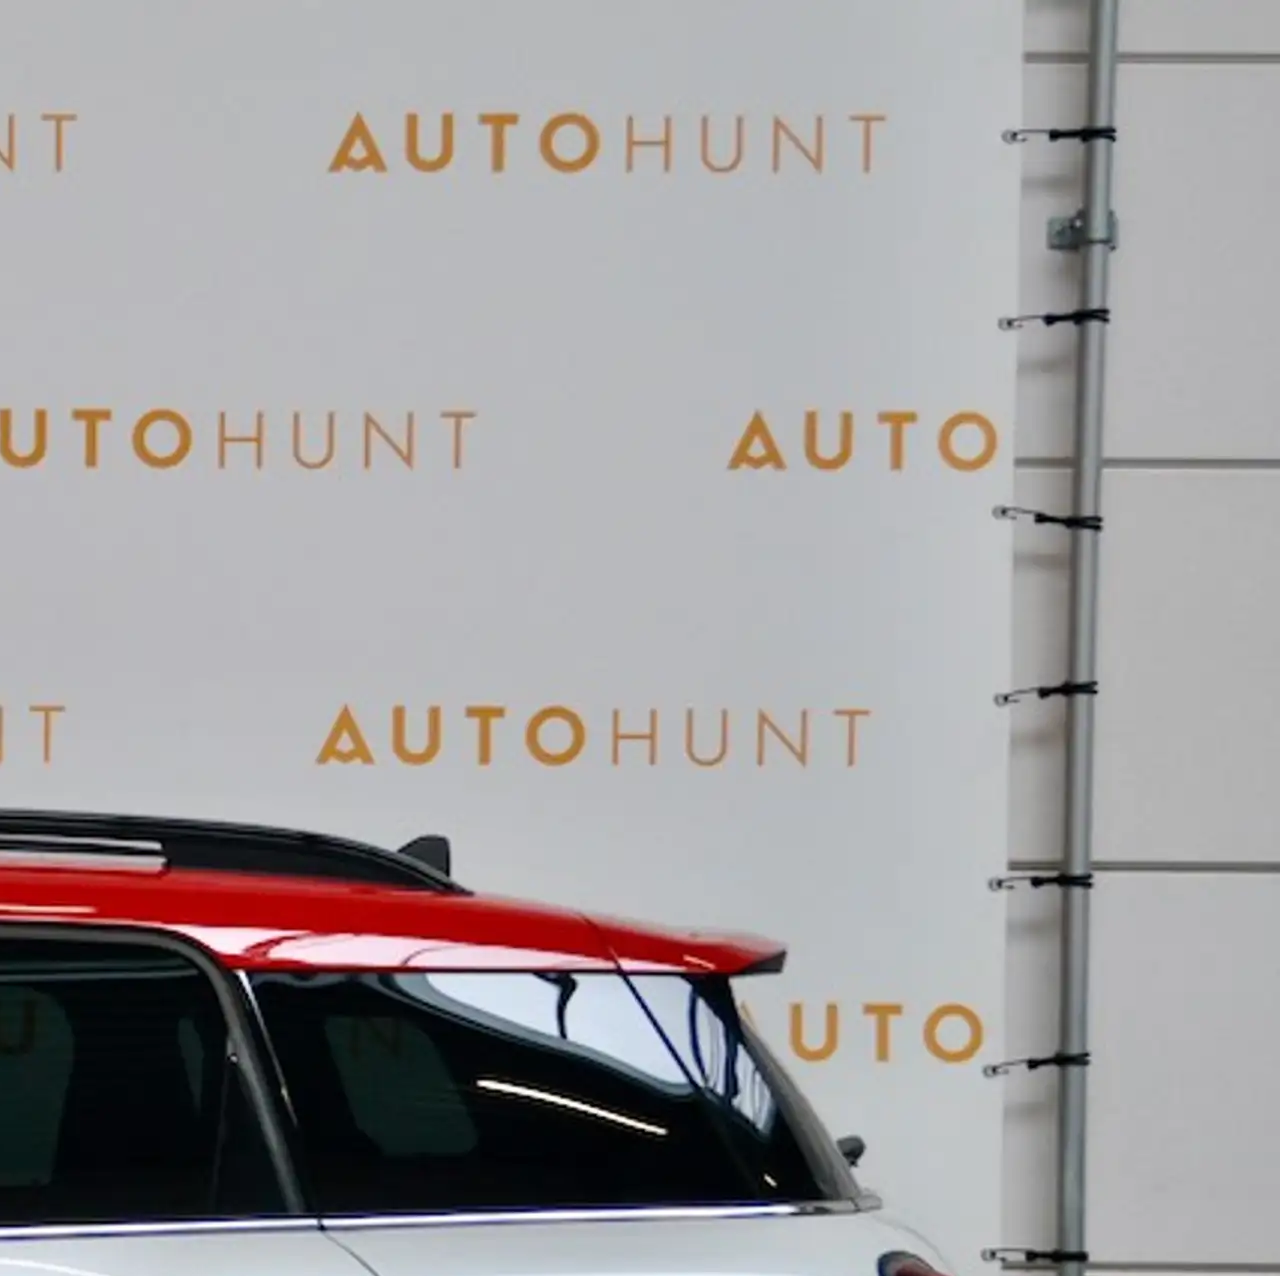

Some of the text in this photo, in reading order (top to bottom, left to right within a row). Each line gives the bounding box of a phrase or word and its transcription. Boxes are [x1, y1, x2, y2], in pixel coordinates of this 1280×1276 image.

[328, 111, 885, 174] AUTOHUNT
[728, 409, 1002, 473] AUTO
[317, 703, 871, 767] AUTOHUNT
[740, 1002, 985, 1064] UTO
